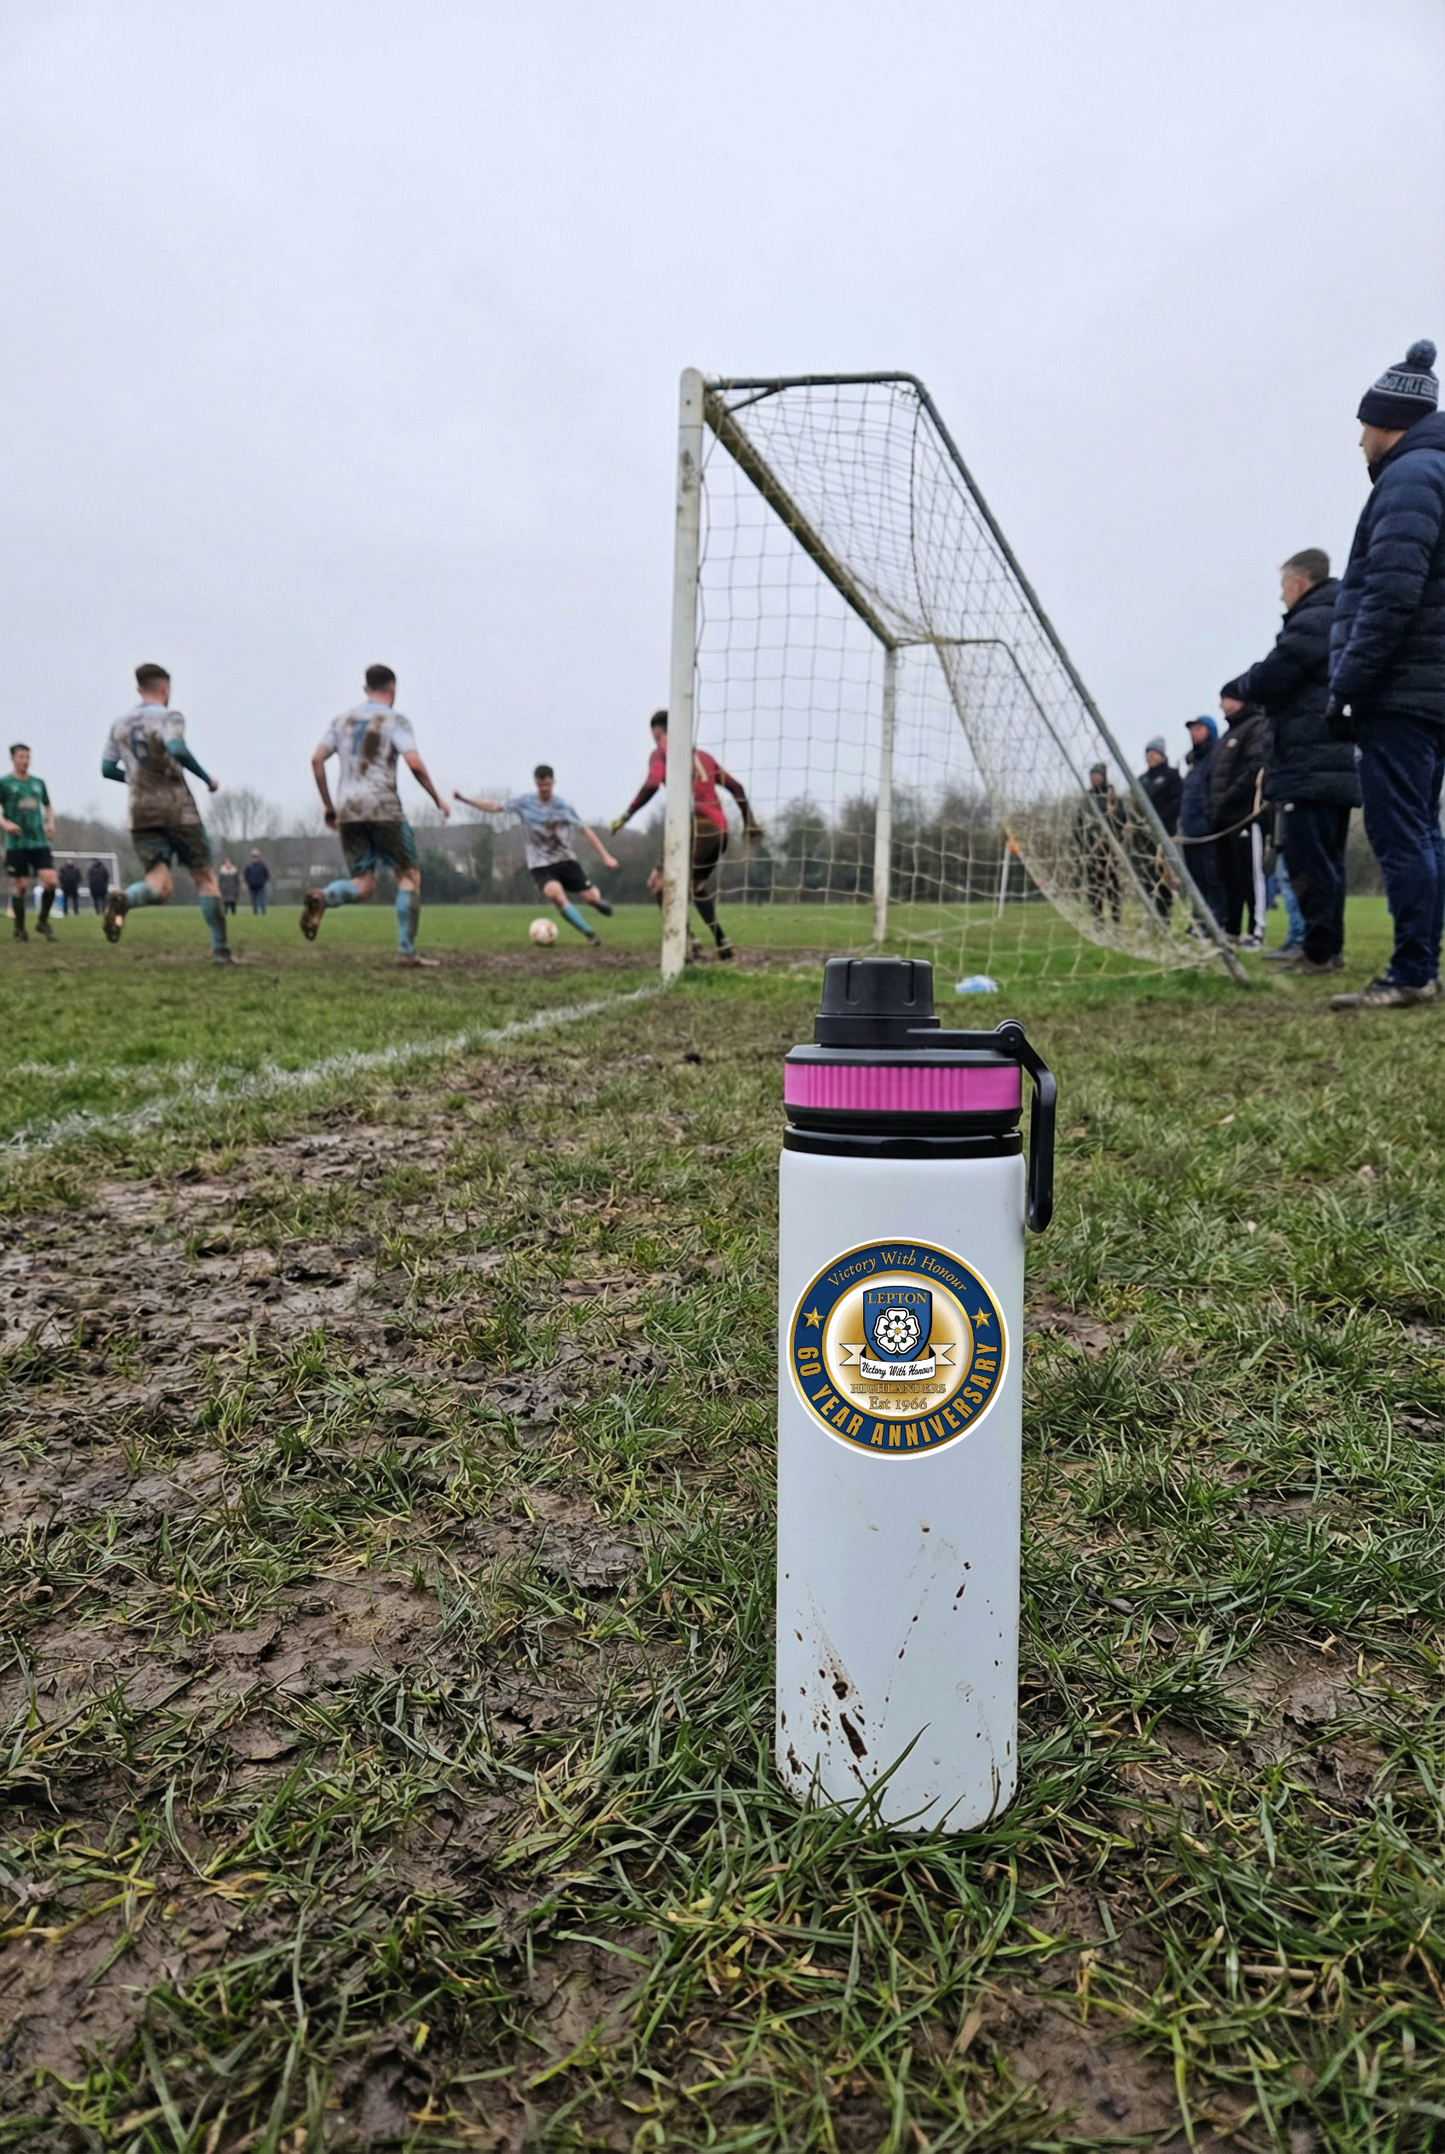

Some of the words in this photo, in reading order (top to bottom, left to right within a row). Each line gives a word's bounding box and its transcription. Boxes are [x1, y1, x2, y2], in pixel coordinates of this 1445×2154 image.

[130, 725, 149, 763] 6
[351, 720, 369, 755] 7
[827, 1256, 875, 1287] Victory
[881, 1250, 916, 1265] With
[920, 1256, 967, 1291] Honour
[867, 1293, 927, 1304] LEPTON
[862, 1362, 887, 1379] Victory
[889, 1365, 906, 1376] With
[908, 1366, 934, 1376] Honour
[798, 1347, 821, 1376] 60
[811, 1384, 864, 1437] YEAR
[871, 1343, 998, 1447] ANNIVERSARY
[851, 1383, 946, 1393] HIGHLANDERS
[869, 1396, 890, 1409] Est
[896, 1399, 927, 1411] 1966
